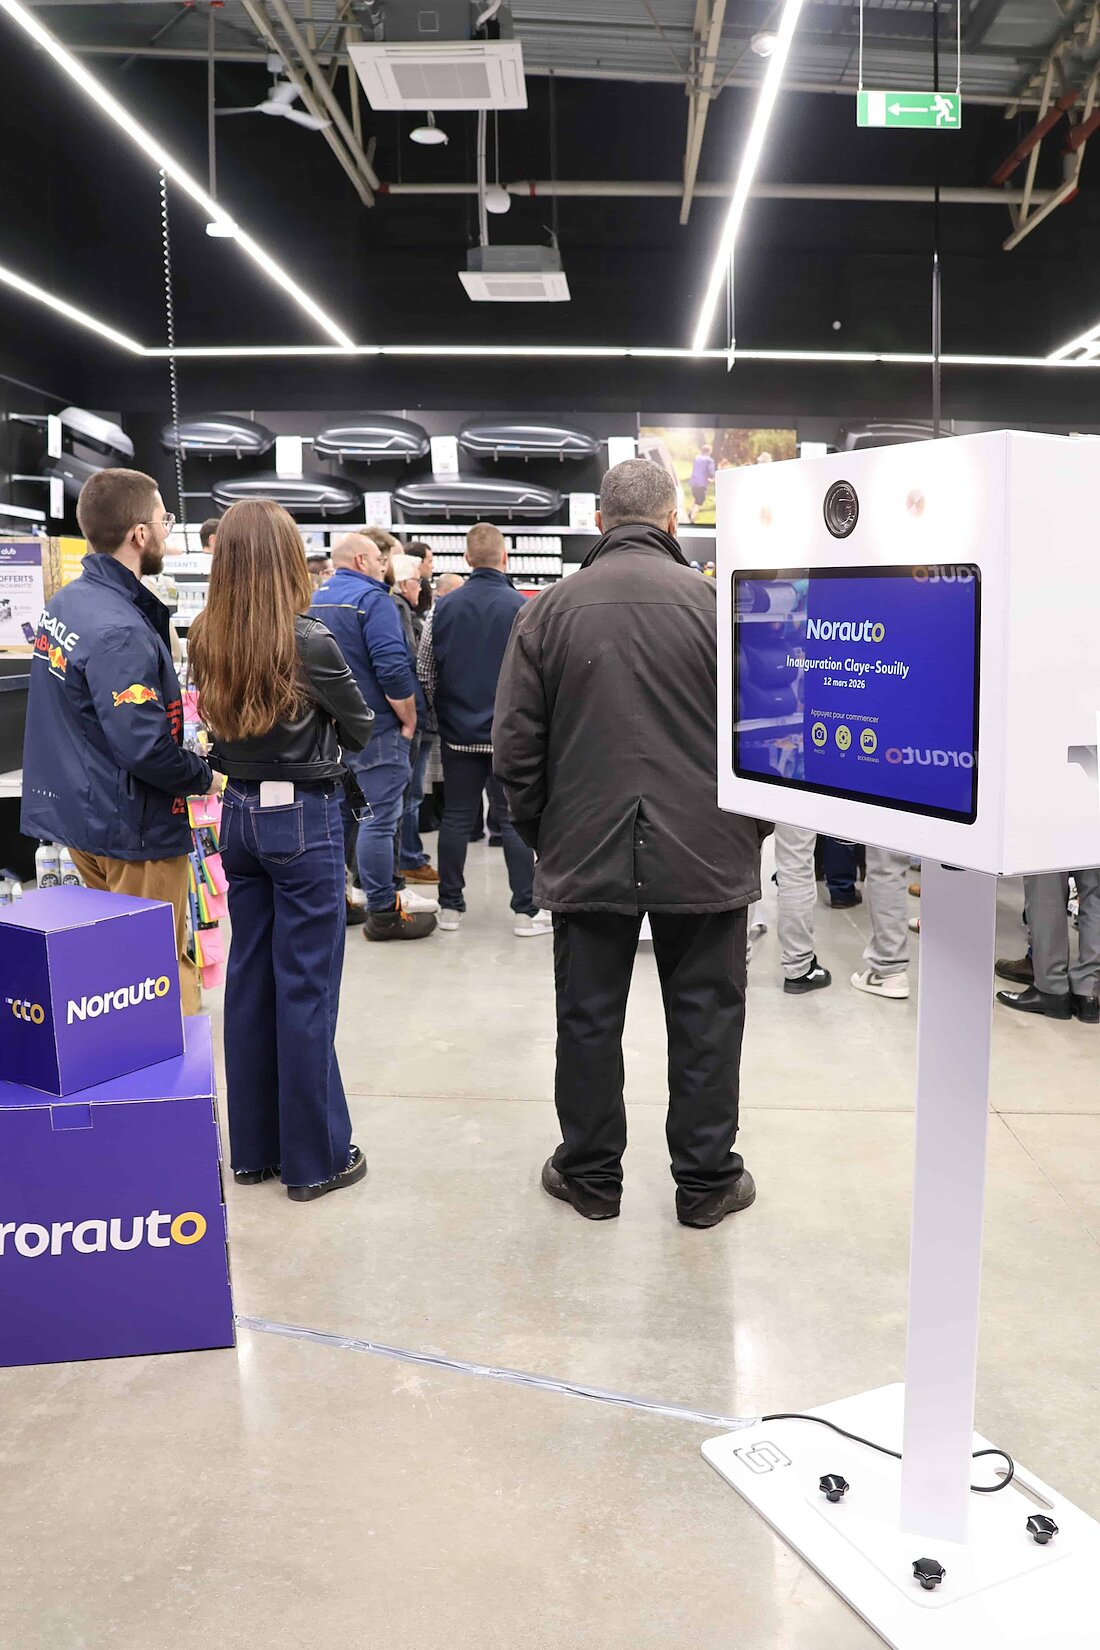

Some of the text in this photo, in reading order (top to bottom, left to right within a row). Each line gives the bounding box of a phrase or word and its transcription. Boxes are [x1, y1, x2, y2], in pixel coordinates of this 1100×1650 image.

[0, 575, 34, 583] OFFERTS
[806, 618, 885, 643] Norauto
[786, 654, 910, 680] Inauguration Claye-Souilly
[823, 677, 866, 689] 12 mars 2026
[811, 708, 879, 724] Appuyez pour commencer
[67, 975, 170, 1025] Norauto
